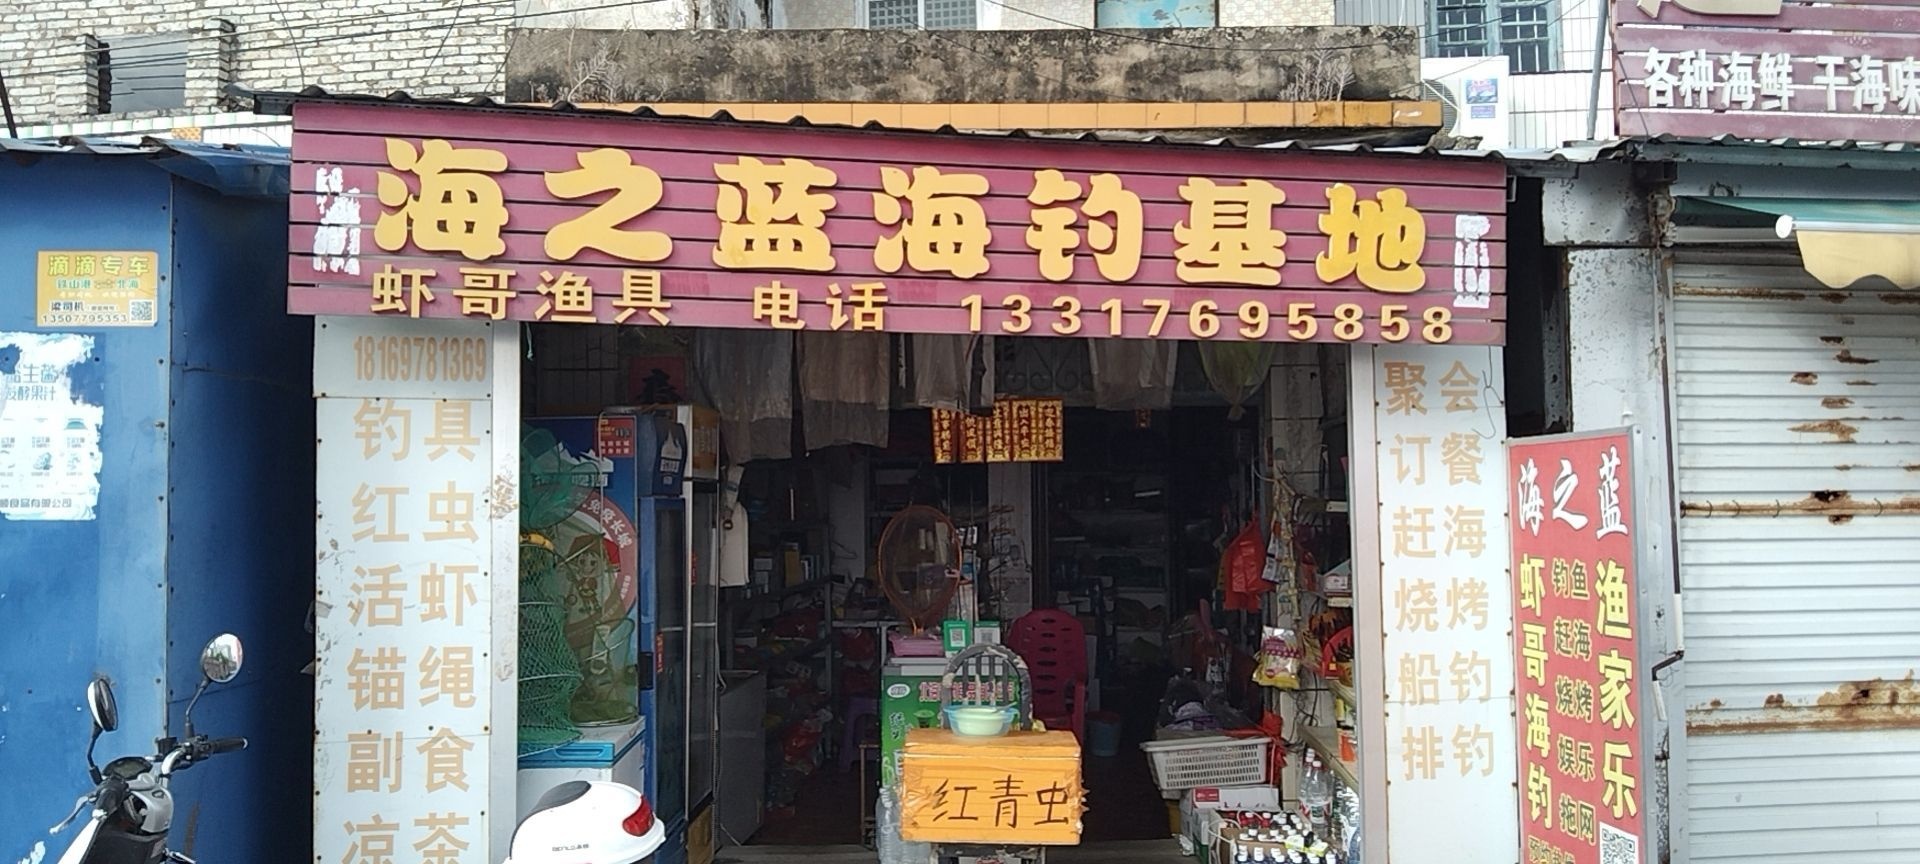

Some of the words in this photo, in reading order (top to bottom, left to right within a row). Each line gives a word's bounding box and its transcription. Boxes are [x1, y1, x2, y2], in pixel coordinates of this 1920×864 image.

[1643, 47, 1795, 111] 各种海鲜
[1812, 54, 1920, 114] 干海味
[374, 138, 1427, 292] 海之蓝海钓基地
[48, 255, 149, 276] 滴滴专车
[42, 314, 128, 323] 13507795353
[370, 263, 672, 327] 虾哥渔具
[752, 279, 888, 331] 电话
[960, 294, 1453, 343] 13317695858
[353, 336, 487, 382] 18169781369
[1383, 360, 1480, 416] 聚会
[353, 397, 481, 463] 钓具
[1389, 432, 1484, 486] 订餐
[351, 480, 480, 544] 红虫
[1517, 445, 1629, 540] 海之蓝
[1392, 505, 1487, 559] 赶海
[347, 562, 479, 627] 活虾
[1394, 577, 1489, 633] 烧烤
[1552, 557, 1591, 601] 钓鱼
[1554, 616, 1593, 662] 赶海
[346, 645, 477, 712] 锚绳
[1398, 650, 1492, 706] 船钓
[1519, 553, 1552, 828] 虾哥海钓
[1555, 674, 1594, 723] 烧烤
[1595, 559, 1637, 819] 渔家乐
[346, 727, 475, 793] 副食
[1401, 724, 1495, 781] 排钓
[1556, 733, 1596, 783] 娱乐
[932, 774, 1069, 829] 红青虫
[1559, 793, 1597, 846] 拖网
[341, 811, 470, 864] 凉茶
